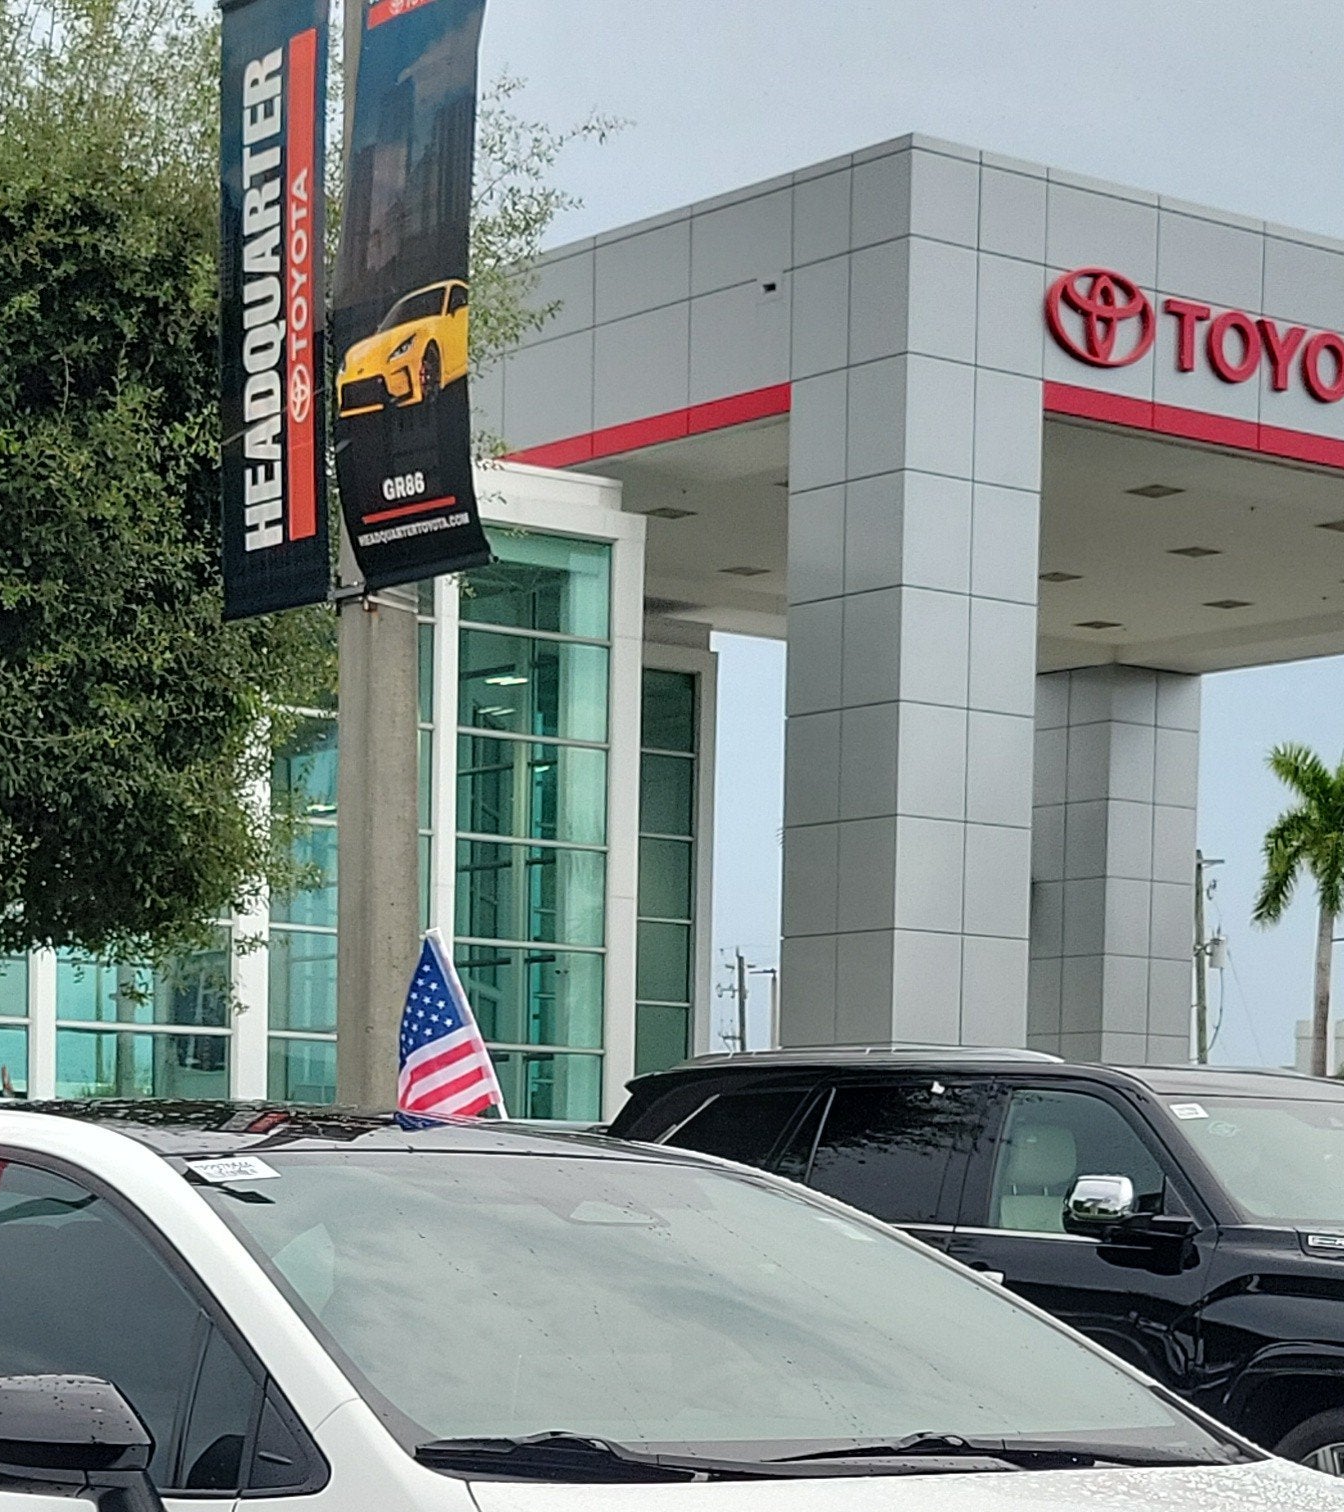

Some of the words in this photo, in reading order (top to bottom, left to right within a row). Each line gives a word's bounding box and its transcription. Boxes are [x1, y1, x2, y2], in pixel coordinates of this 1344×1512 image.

[243, 46, 285, 552] HEADQUARTER
[289, 166, 309, 361] TOYOTA
[382, 471, 426, 501] GR86
